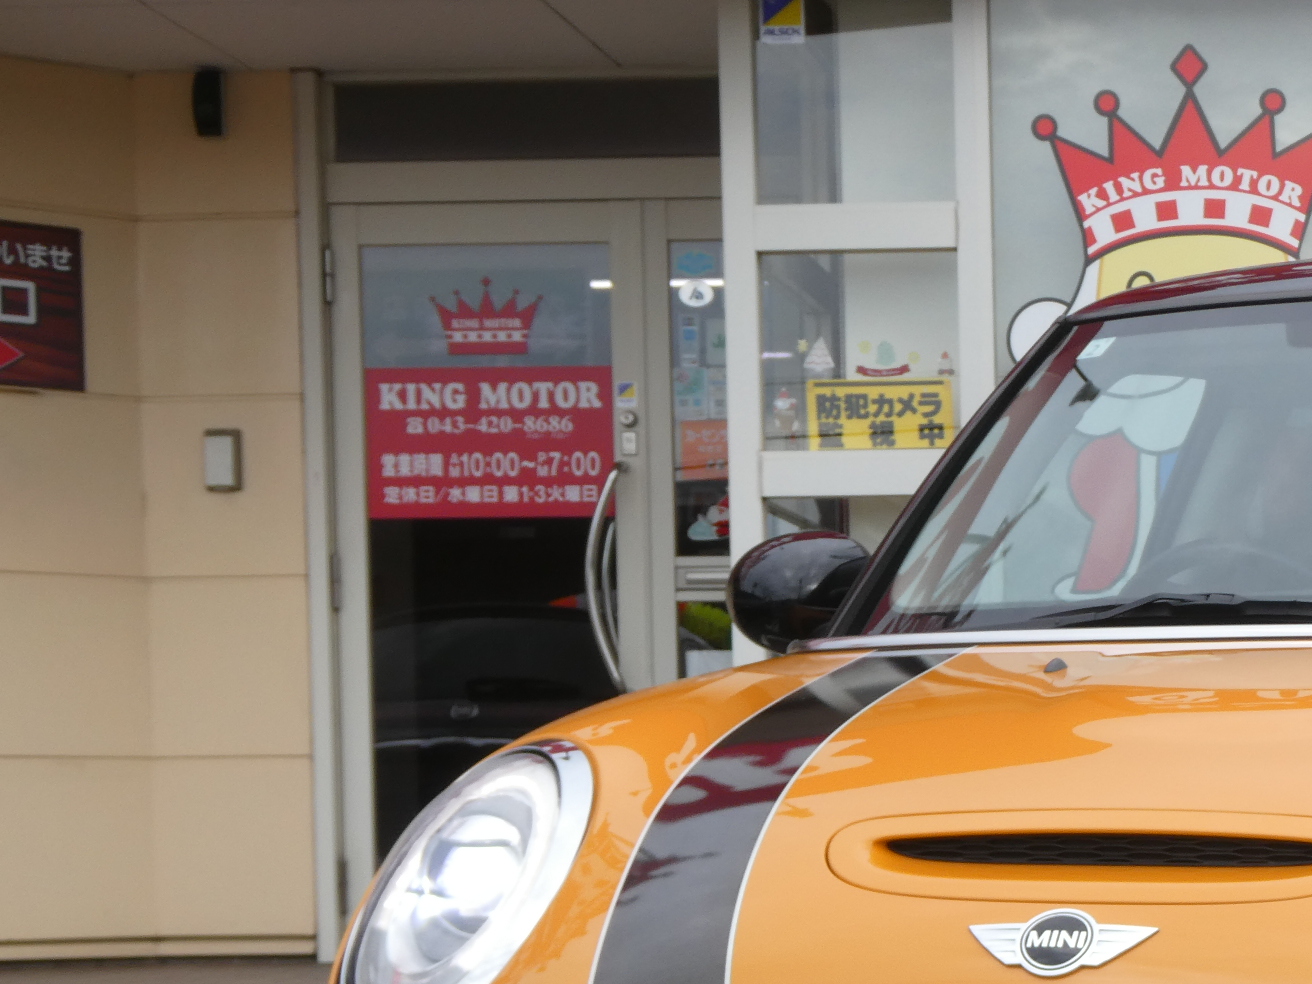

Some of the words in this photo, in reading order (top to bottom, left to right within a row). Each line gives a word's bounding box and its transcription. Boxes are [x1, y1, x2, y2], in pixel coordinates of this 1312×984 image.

[1078, 168, 1166, 215] KING
[1180, 165, 1304, 207] MOTOR
[0, 240, 73, 272] いませ
[378, 383, 467, 410] KING
[478, 381, 603, 409] MOTOR
[816, 390, 942, 420] 防犯カメラ
[427, 415, 574, 434] 043-420-8686
[1026, 930, 1087, 949] MINI
